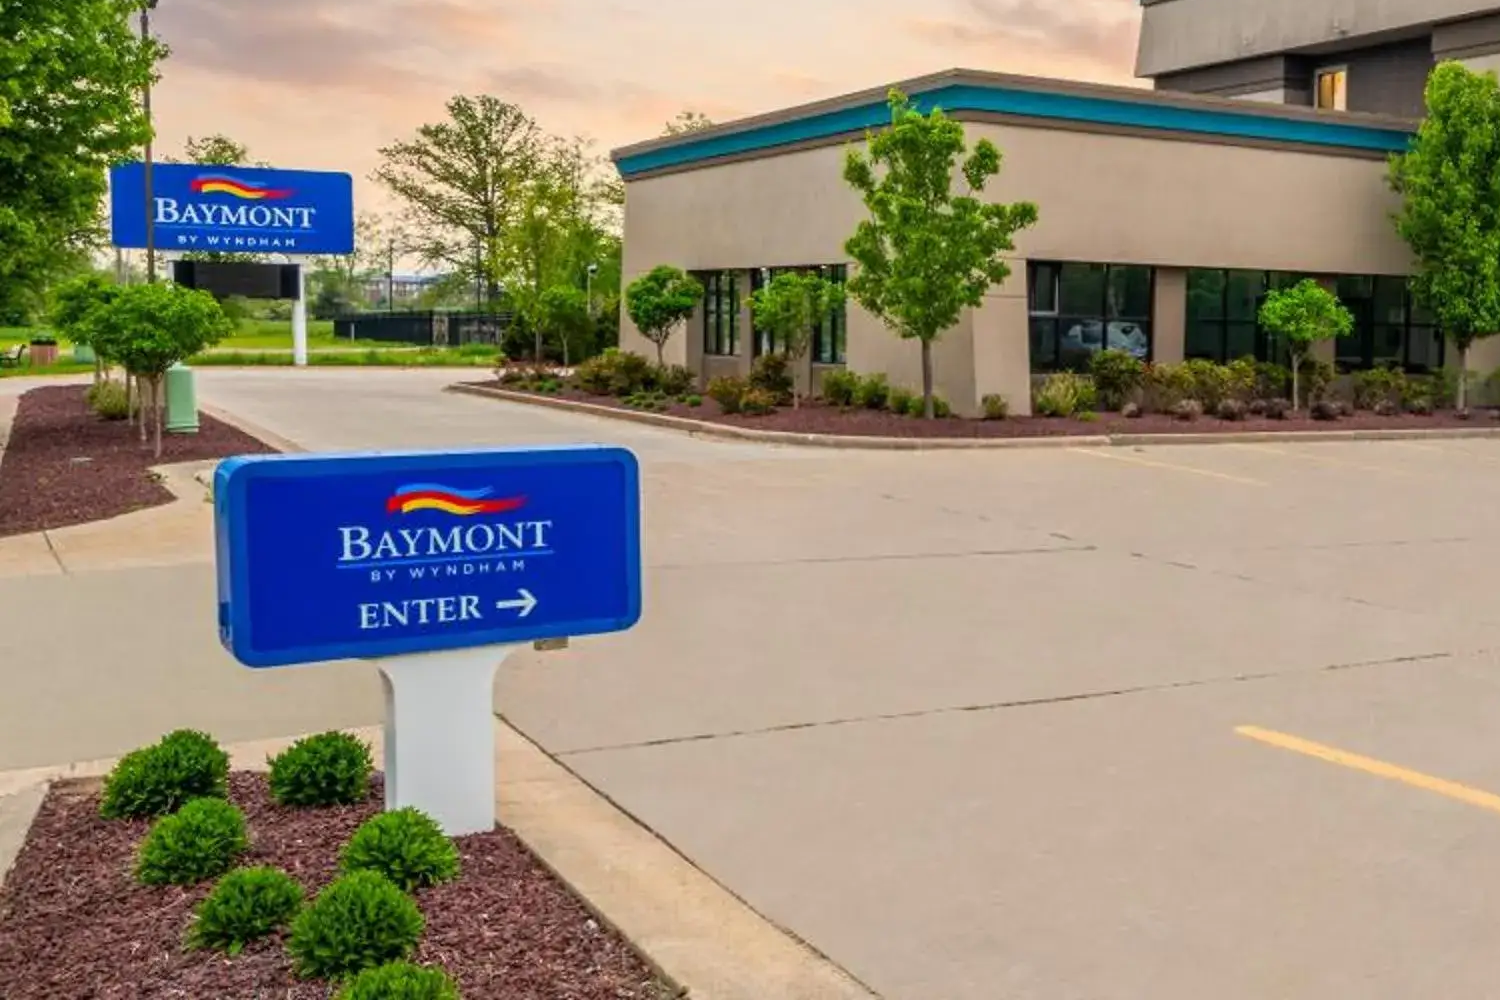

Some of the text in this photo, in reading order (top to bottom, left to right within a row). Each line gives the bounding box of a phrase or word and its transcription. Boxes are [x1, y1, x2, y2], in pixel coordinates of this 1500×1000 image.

[154, 197, 316, 228] BAYMONT
[177, 235, 296, 247] BY WYNDHAM
[338, 520, 552, 561] BAYMONT
[370, 560, 526, 582] BY WYNDHAM
[359, 595, 483, 630] ENTER
